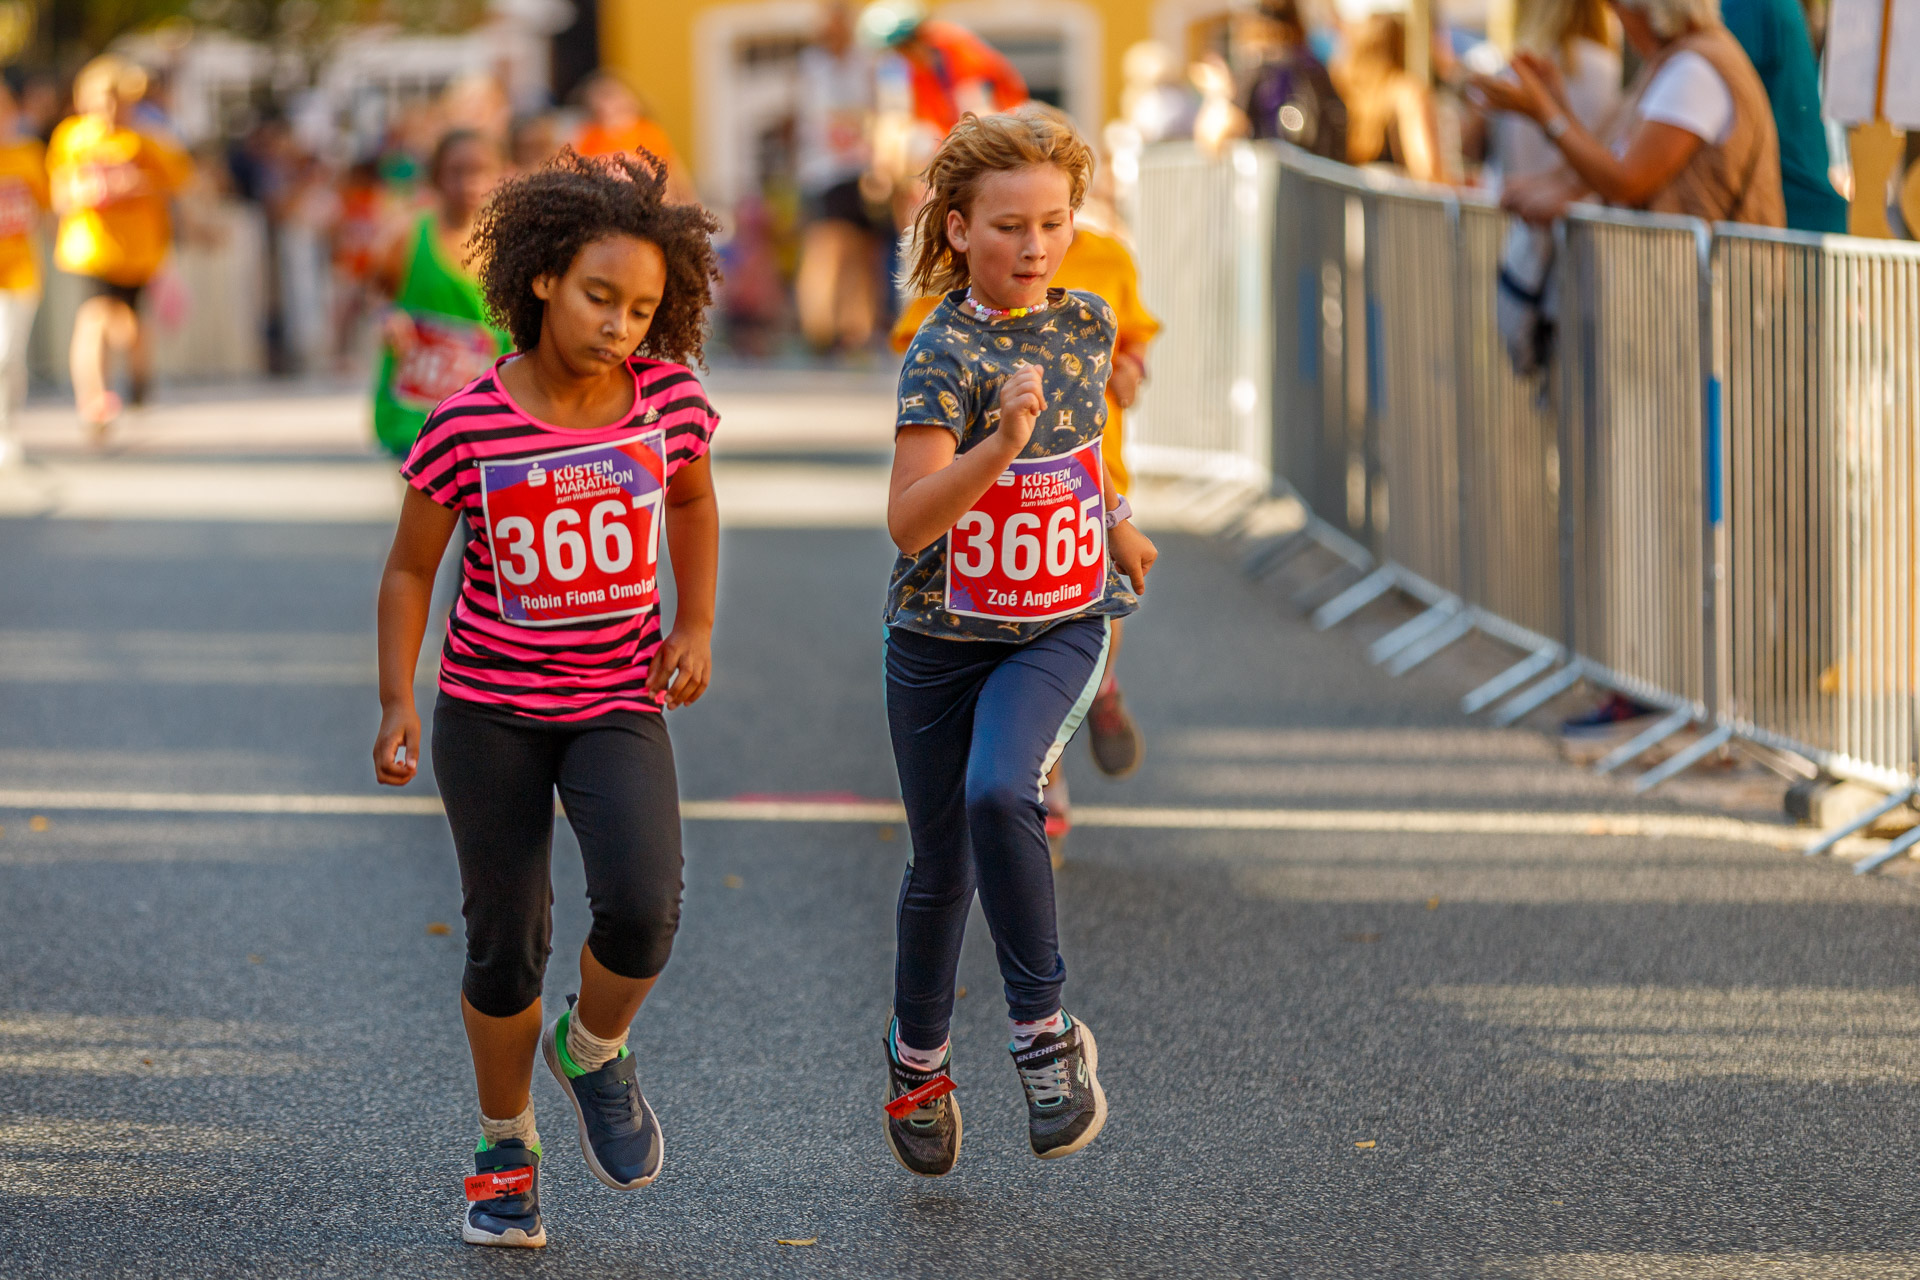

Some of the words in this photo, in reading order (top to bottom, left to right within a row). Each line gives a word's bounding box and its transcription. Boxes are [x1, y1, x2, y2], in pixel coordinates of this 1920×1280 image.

[926, 366, 949, 378] Potter
[553, 459, 613, 482] KÜSTEN
[1022, 467, 1071, 487] KÜSTEN
[555, 469, 633, 496] MARATHON
[1021, 476, 1082, 500] MARATHON
[556, 494, 572, 504] zum
[573, 486, 620, 501] Weltkindertag
[1020, 500, 1036, 508] zum
[1037, 492, 1074, 506] Weltkindertag
[495, 488, 663, 585] 3667
[954, 494, 1102, 581] 3665
[520, 594, 562, 609] Robin
[566, 588, 606, 606] Fiona
[987, 588, 1018, 607] Zoé
[1022, 583, 1082, 608] Angelina
[1016, 1041, 1068, 1063] SKECHERS
